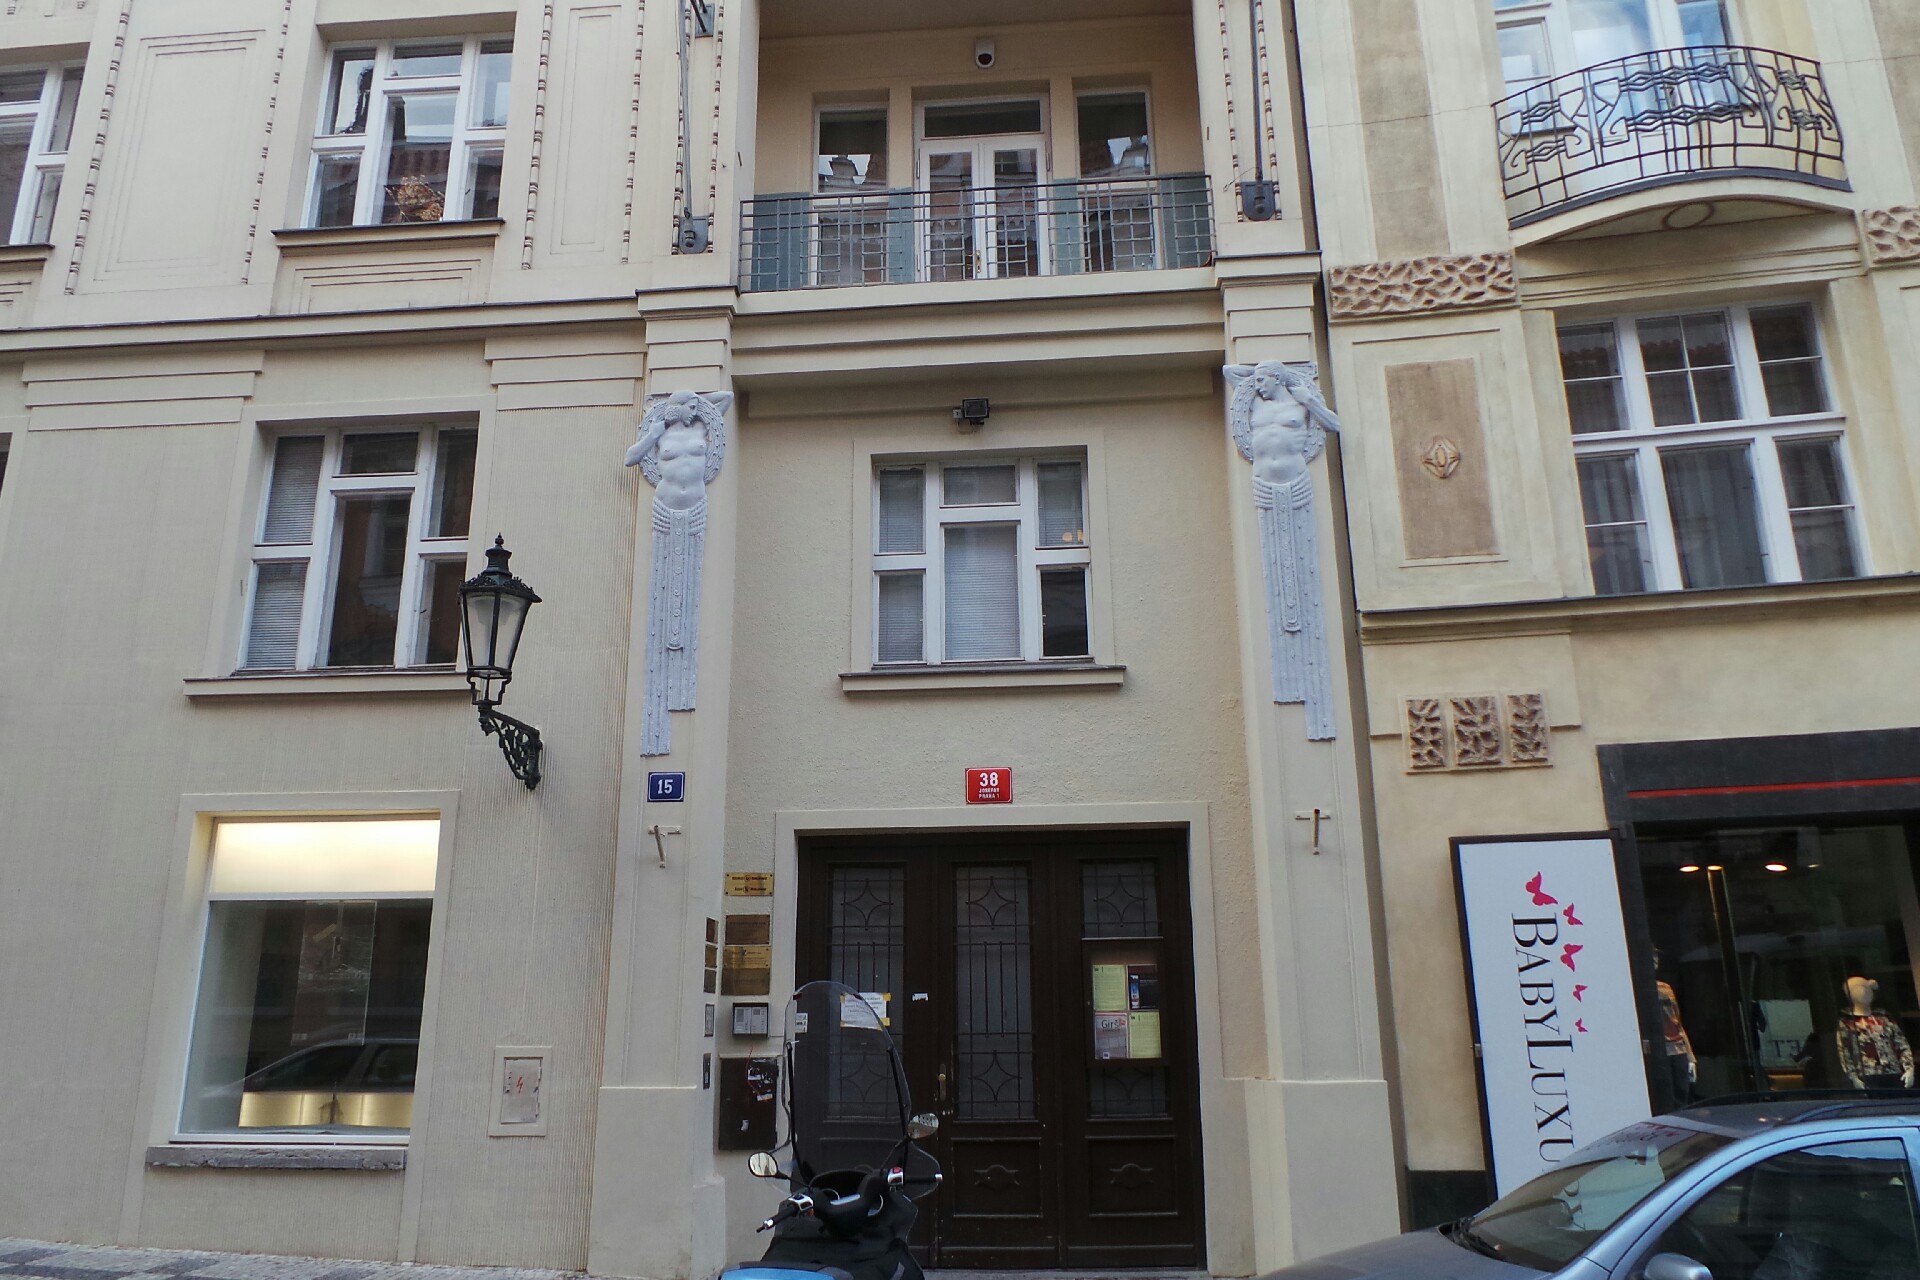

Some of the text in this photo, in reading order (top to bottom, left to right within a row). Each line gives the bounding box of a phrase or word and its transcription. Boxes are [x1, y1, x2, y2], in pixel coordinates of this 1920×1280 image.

[657, 779, 674, 795] 15
[980, 772, 999, 787] 38
[1511, 911, 1587, 1232] BABYLUXU
